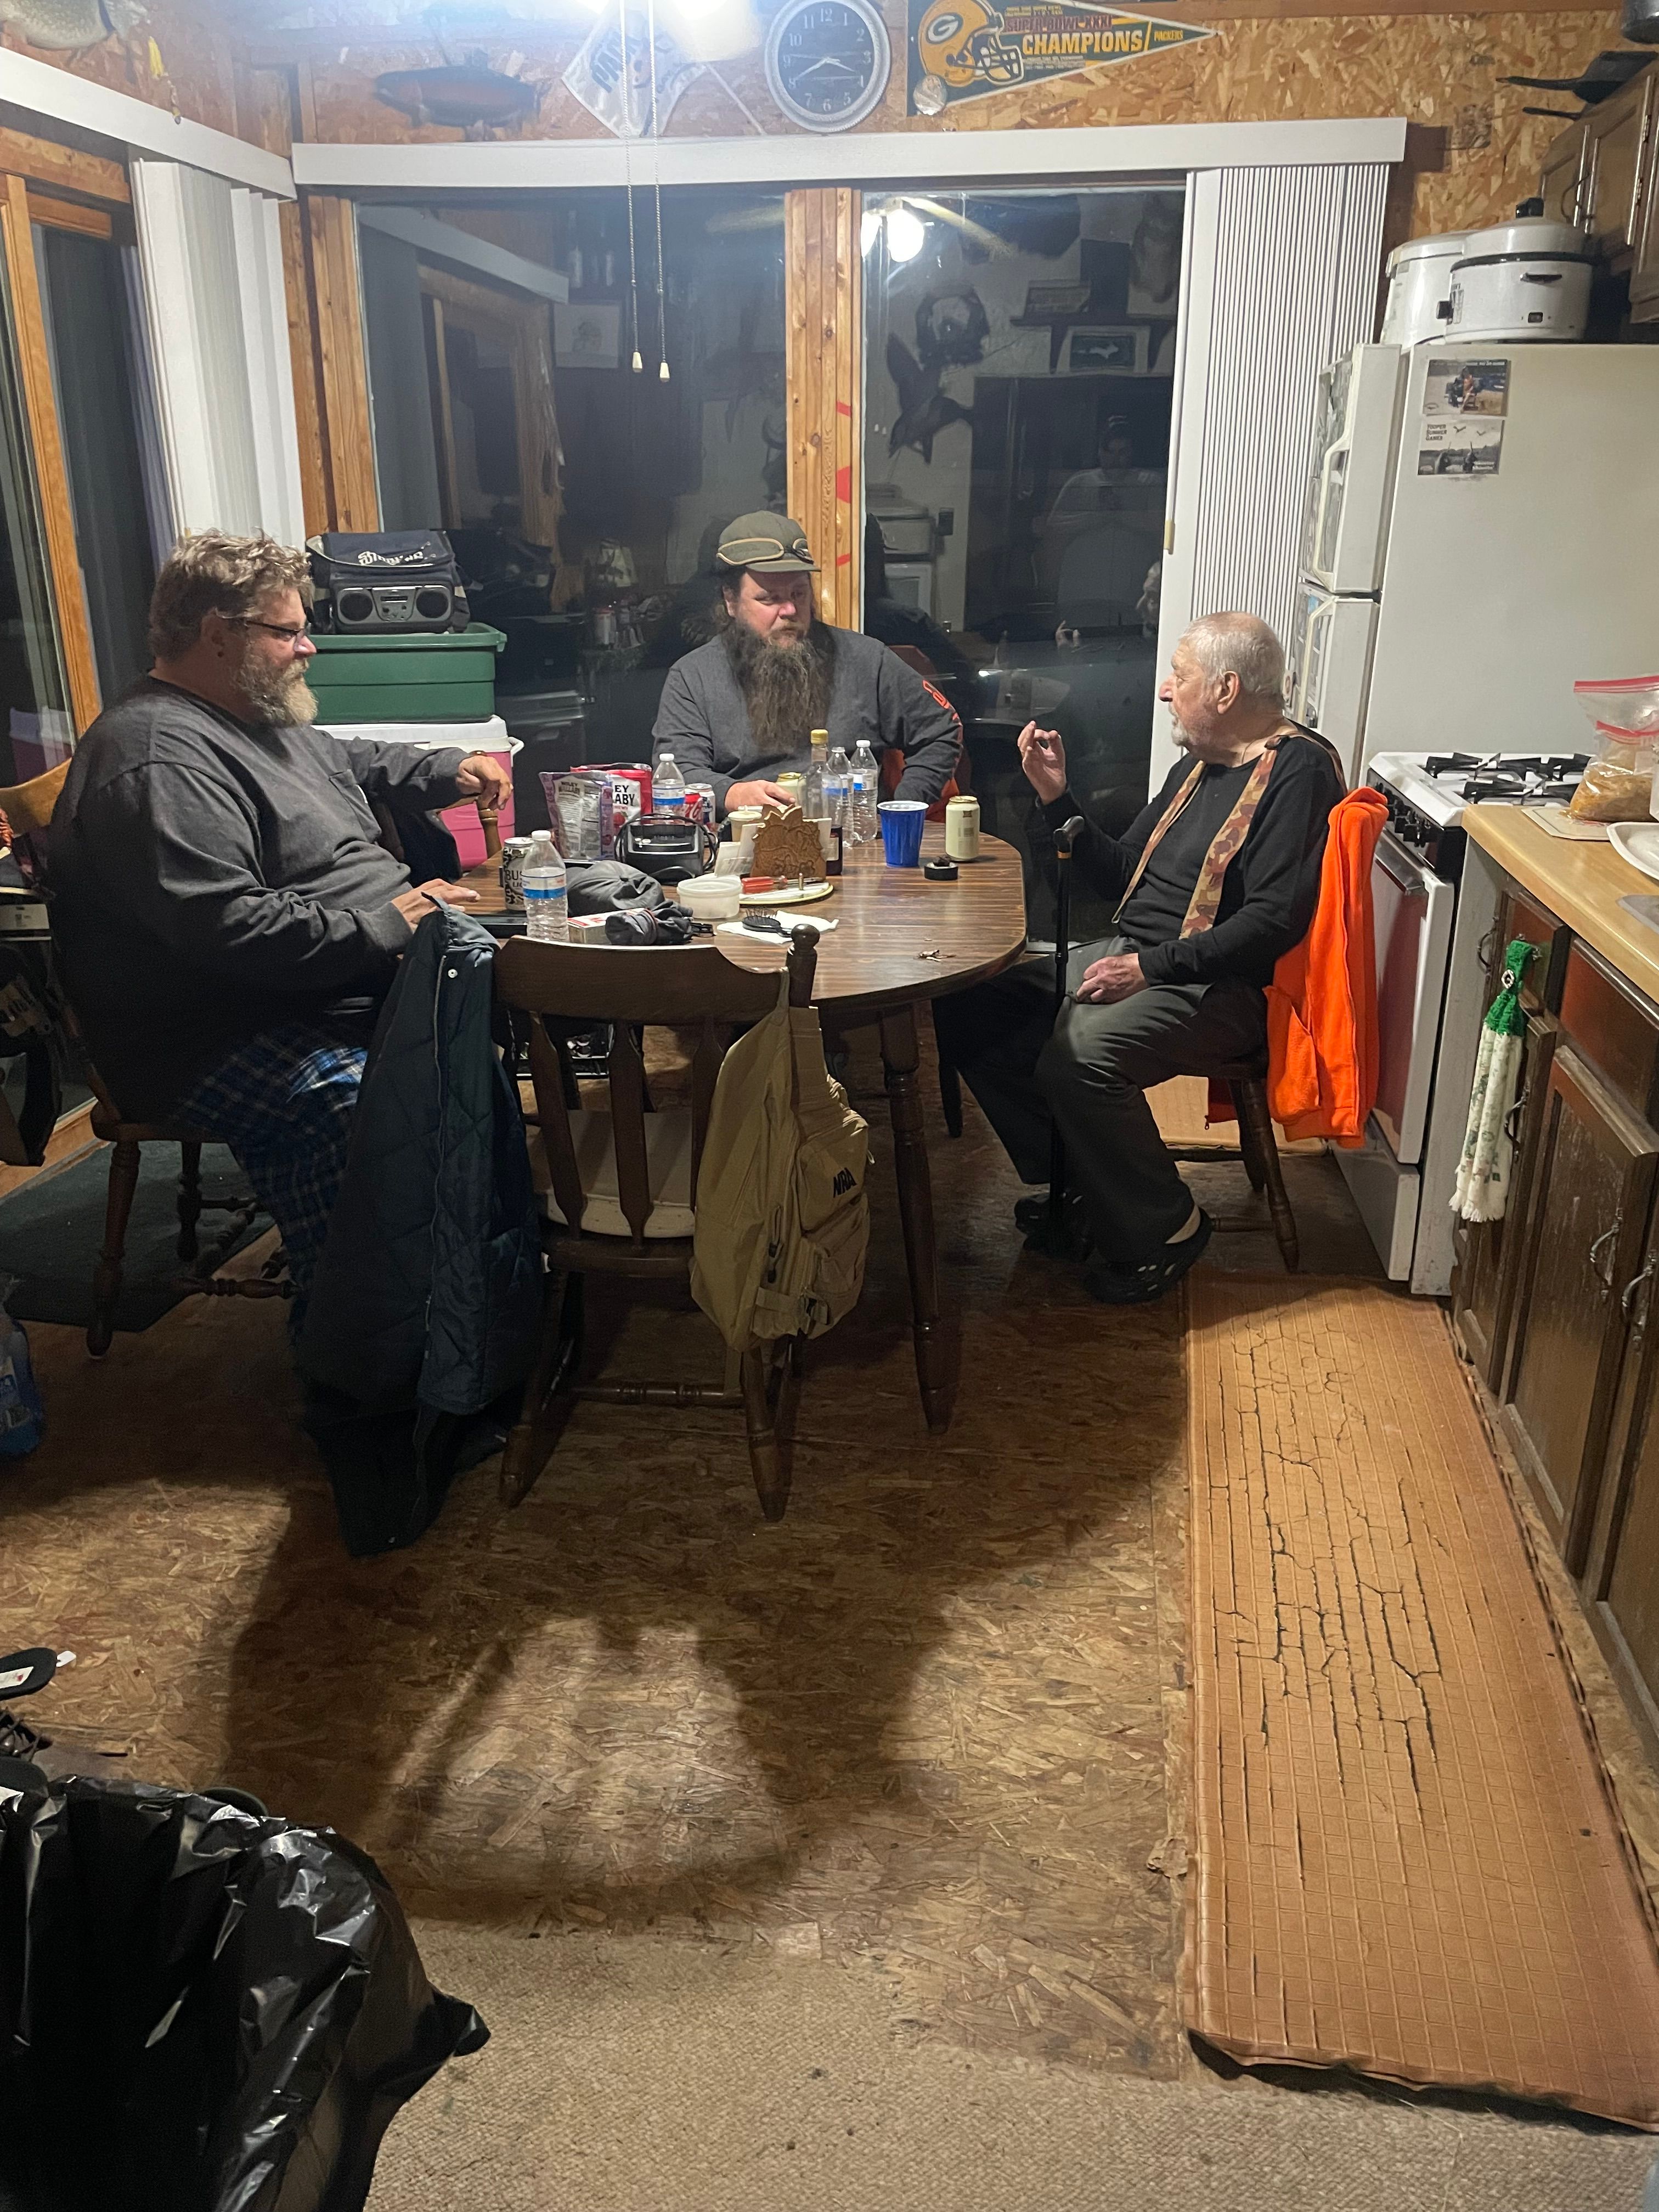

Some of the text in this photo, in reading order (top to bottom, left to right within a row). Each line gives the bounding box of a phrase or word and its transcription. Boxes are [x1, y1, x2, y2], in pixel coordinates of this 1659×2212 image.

[820, 8, 833, 22] 12
[789, 33, 802, 47] 10
[856, 29, 865, 42] 2
[1023, 30, 1143, 55] CHAMPIONS
[614, 785, 629, 793] EY
[614, 793, 635, 806] ABY
[833, 1167, 857, 1198] NRA
